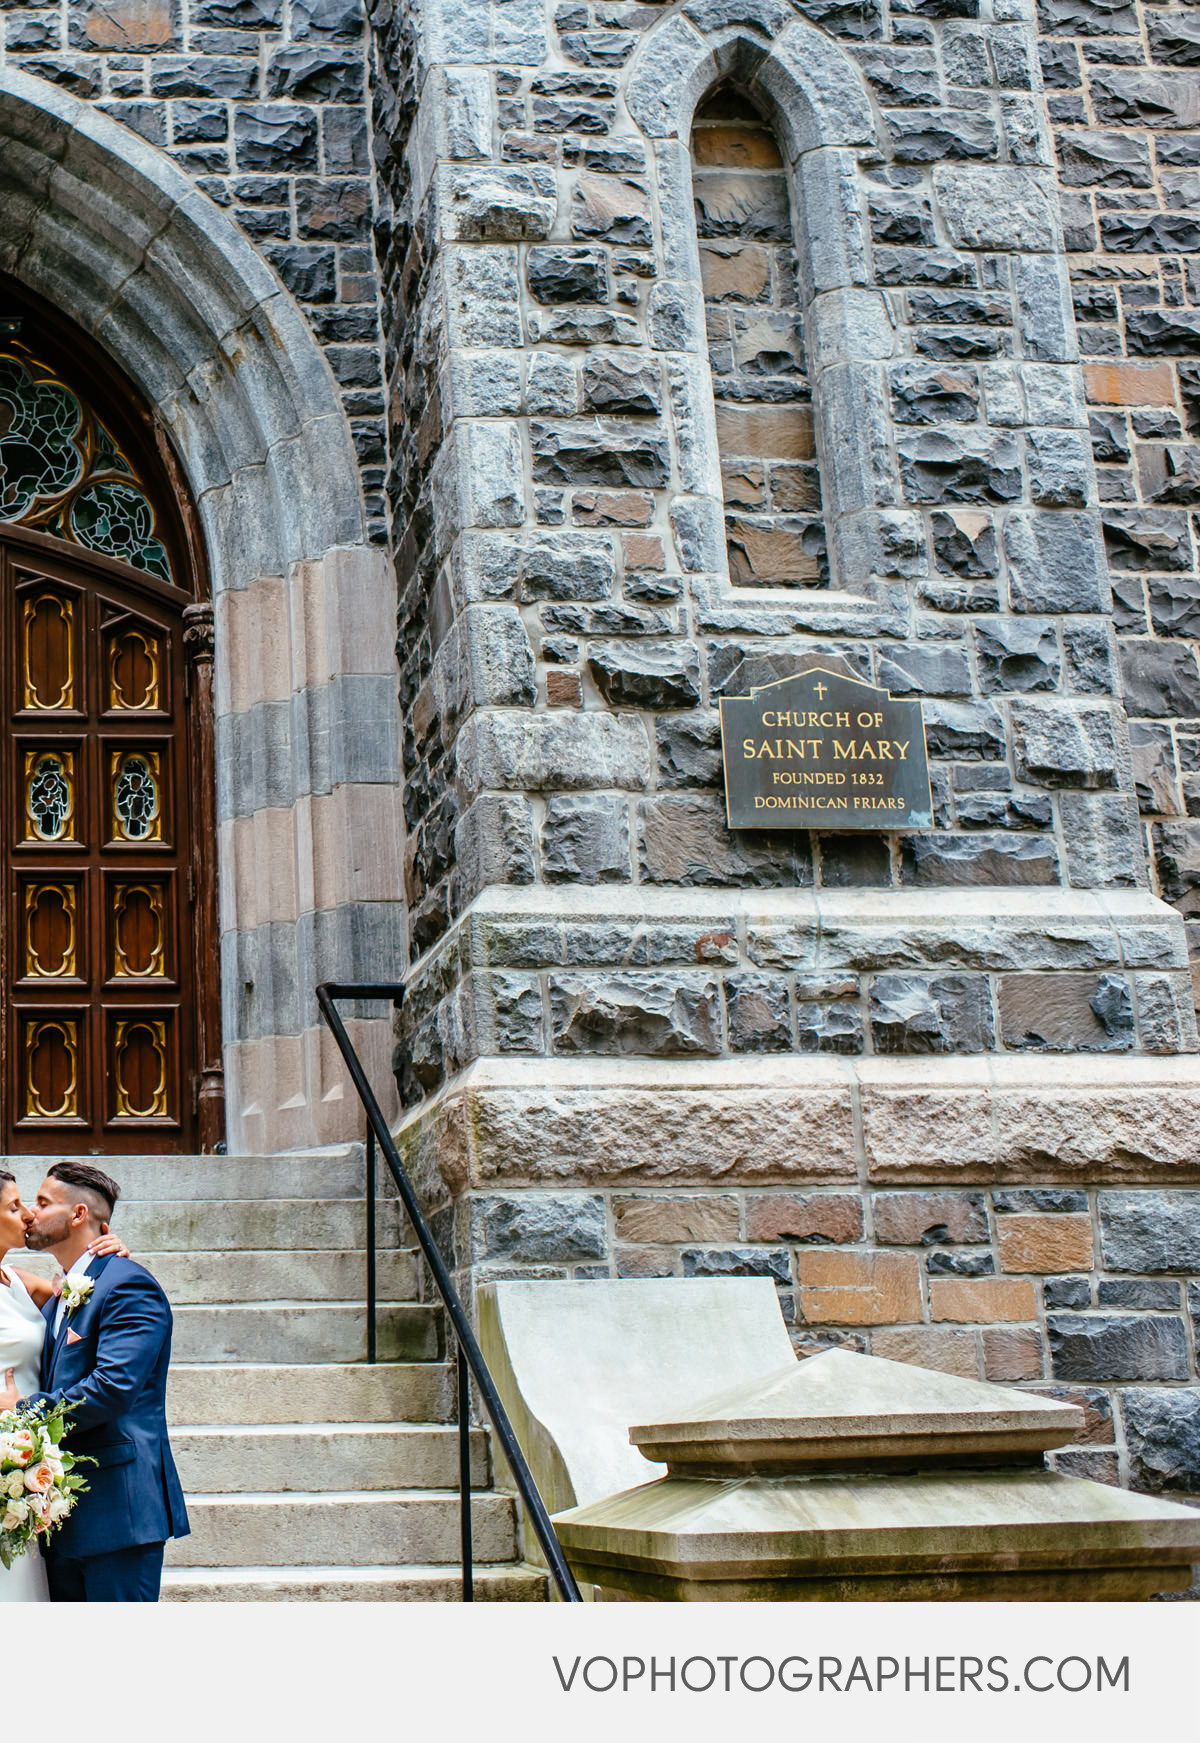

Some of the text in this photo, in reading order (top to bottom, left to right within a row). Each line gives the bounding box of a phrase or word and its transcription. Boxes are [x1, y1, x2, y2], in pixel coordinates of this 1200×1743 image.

[762, 711, 884, 728] CHURCH OF
[743, 739, 910, 760] SAINT MARY
[773, 772, 884, 785] FOUNDED 1832
[754, 796, 905, 809] DOMINICAN FRIARS
